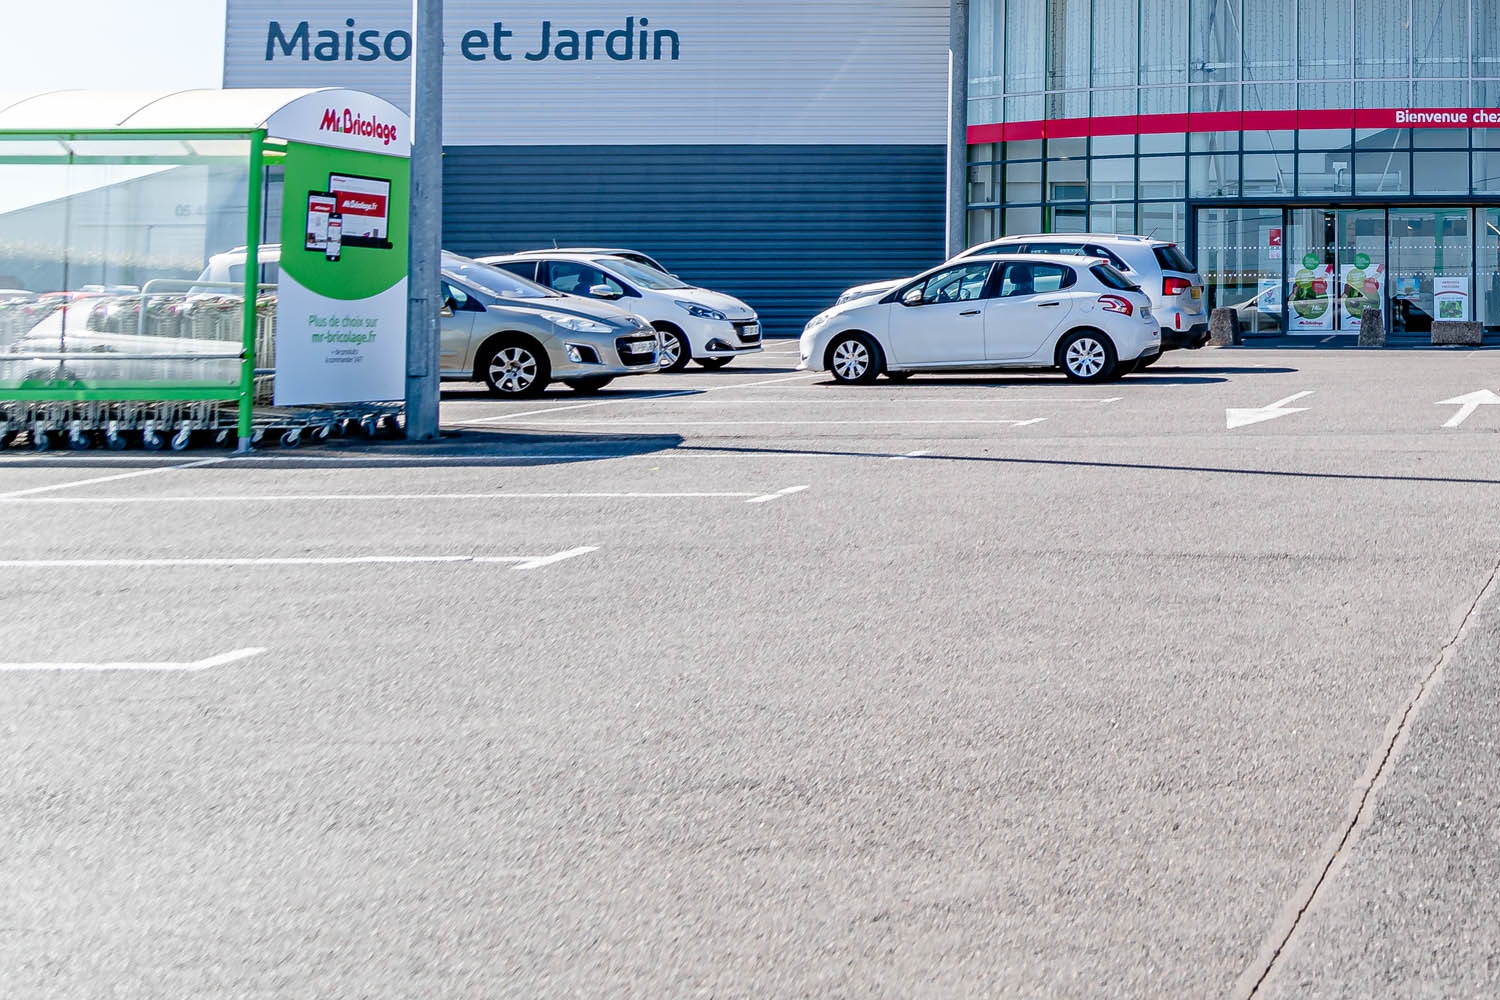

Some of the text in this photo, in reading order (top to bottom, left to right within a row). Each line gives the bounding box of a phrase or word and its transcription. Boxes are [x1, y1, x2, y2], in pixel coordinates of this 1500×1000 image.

[265, 16, 680, 61] Maiso et Jardin
[1395, 110, 1467, 123] Bienvenue
[308, 315, 378, 328] Plus de choix sur
[312, 331, 376, 345] mr-bricolage.fr
